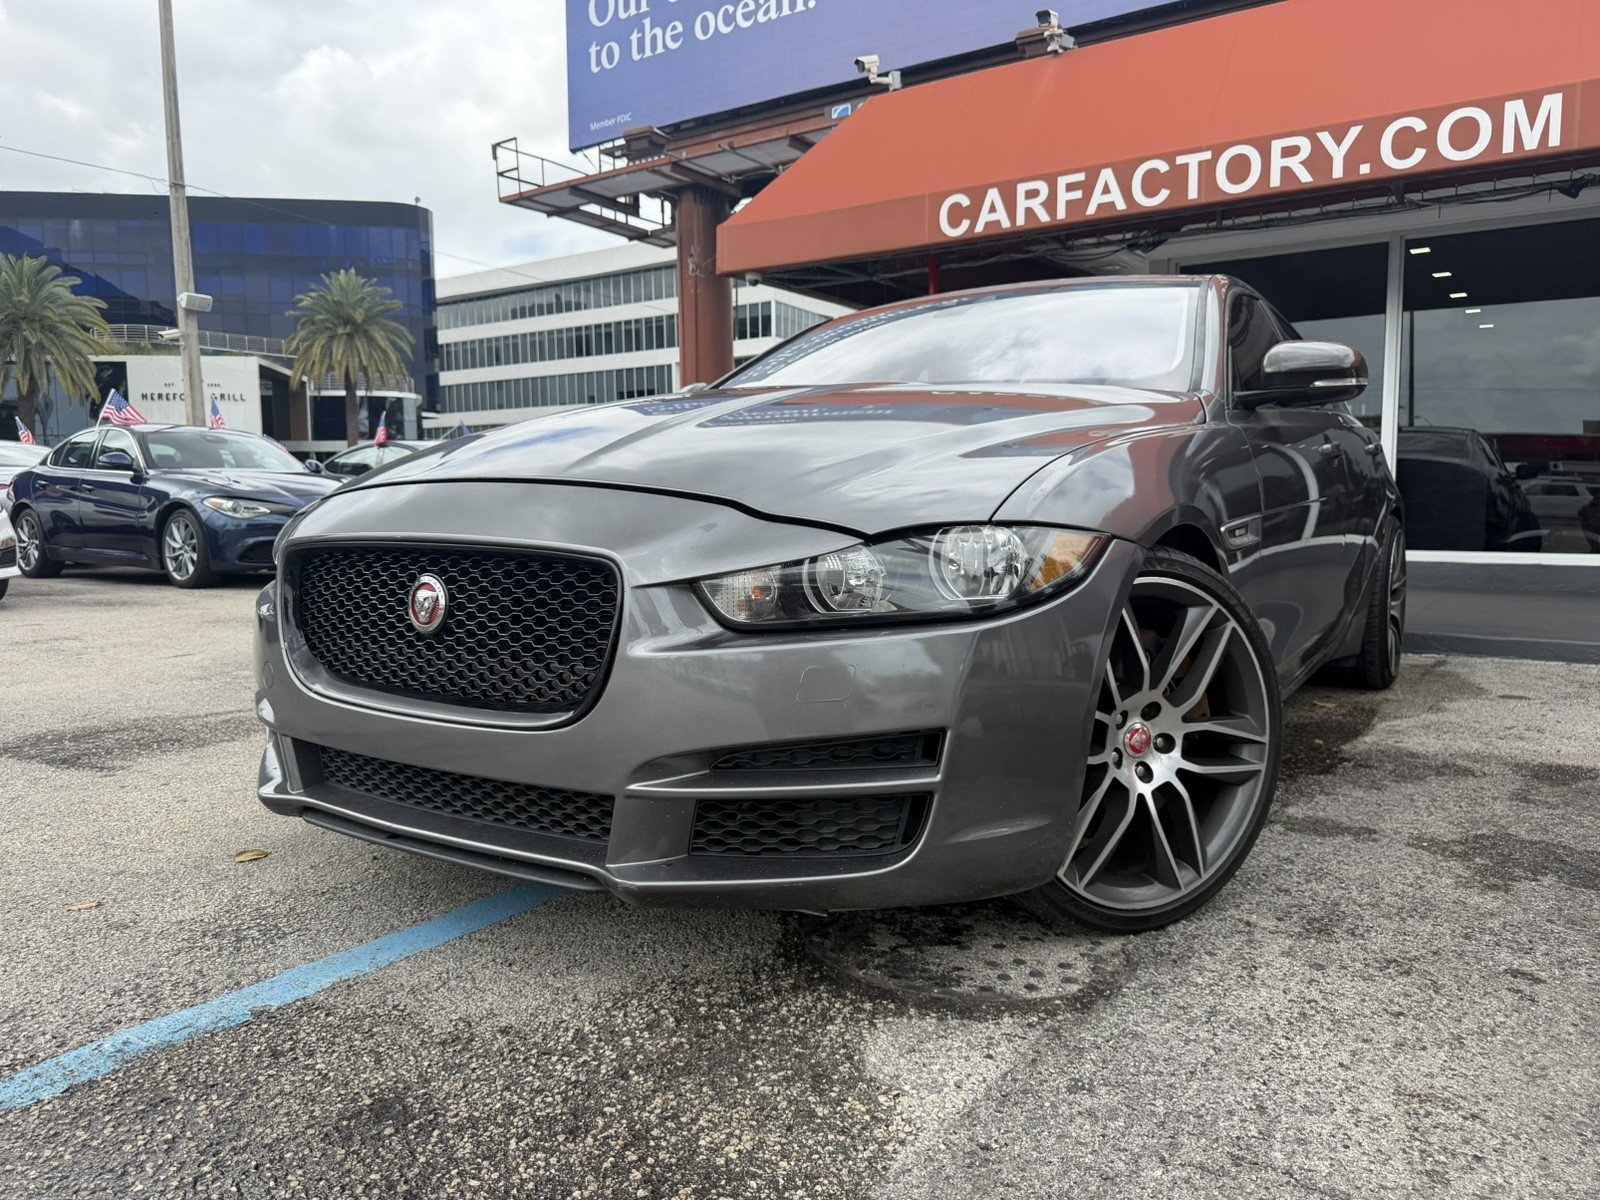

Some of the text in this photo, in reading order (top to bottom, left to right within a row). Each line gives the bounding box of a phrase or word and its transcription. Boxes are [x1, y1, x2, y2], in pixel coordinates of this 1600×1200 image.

[588, 0, 817, 74] to the ocean.
[590, 111, 632, 131] Member FDIC
[938, 92, 1564, 239] CARFACTORY.COM
[210, 392, 247, 402] GRILL
